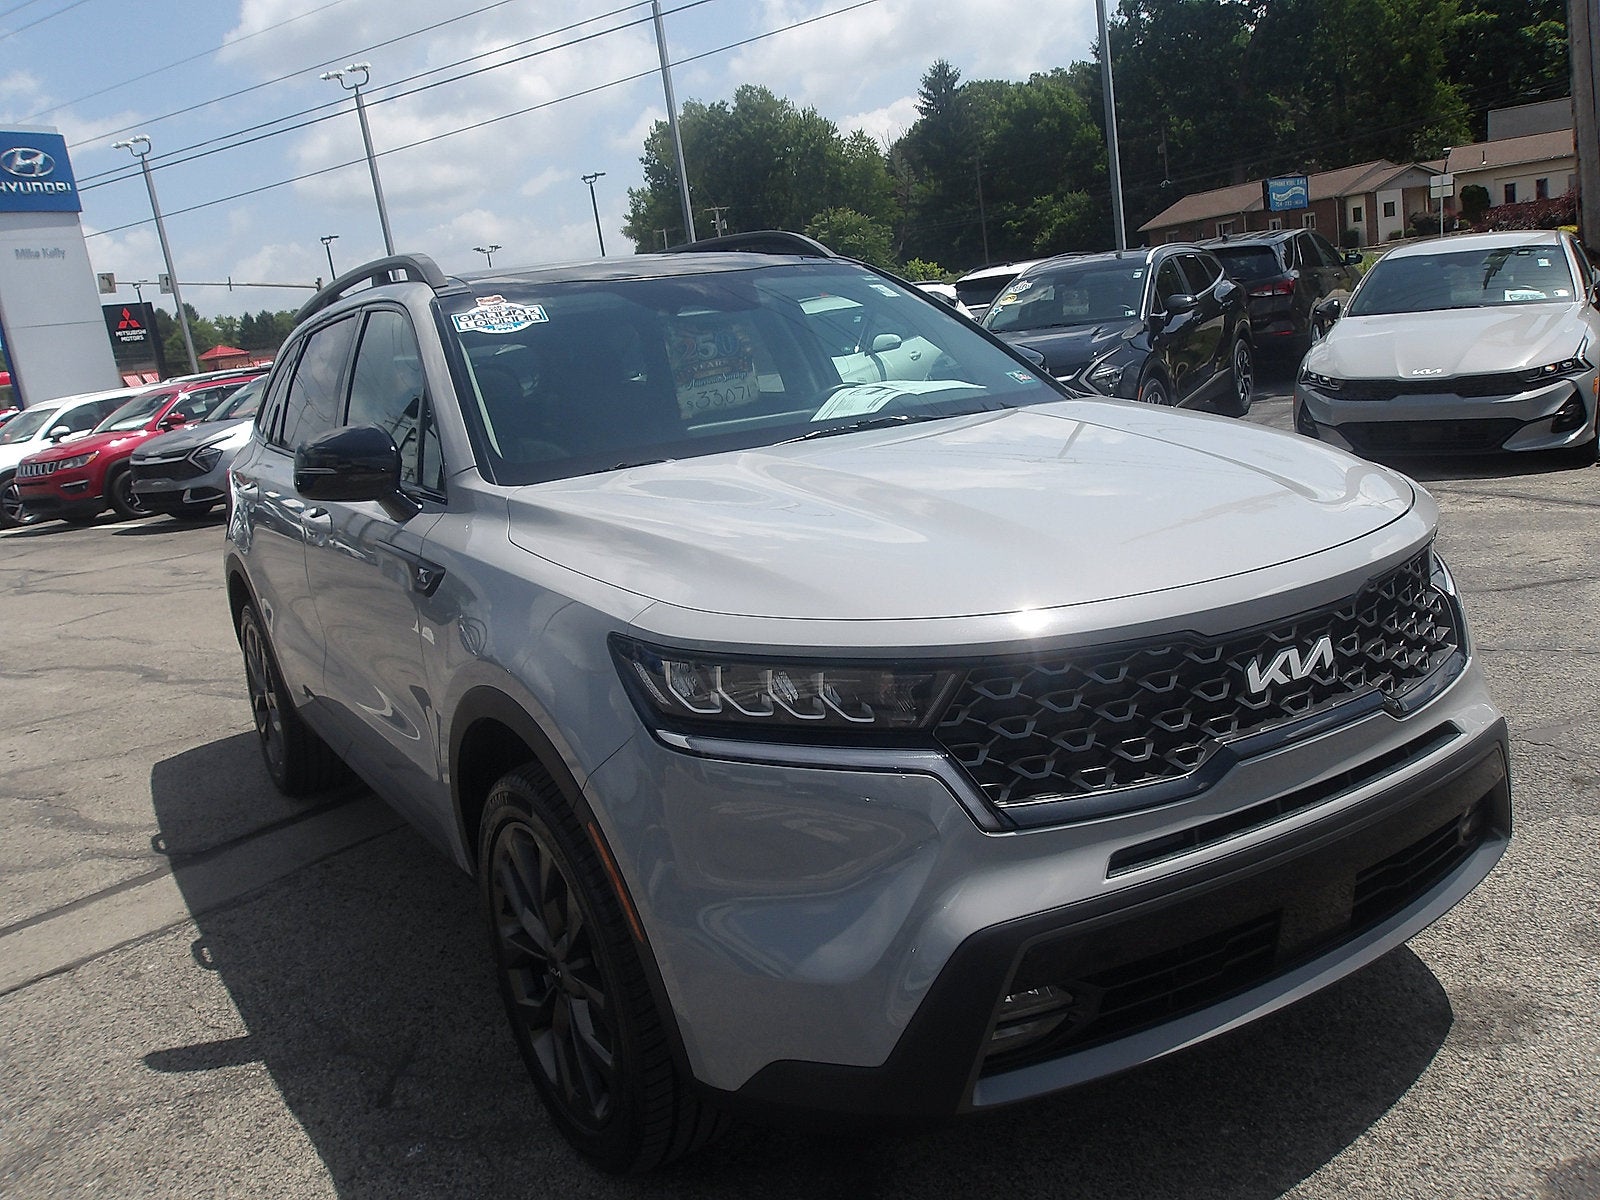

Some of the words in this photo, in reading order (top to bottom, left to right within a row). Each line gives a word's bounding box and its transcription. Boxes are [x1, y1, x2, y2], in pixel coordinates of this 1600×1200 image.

[15, 248, 40, 260] Mike
[42, 247, 66, 260] Kelly
[115, 329, 147, 338] MITSUBISHI
[120, 335, 145, 343] MOTORS
[1247, 636, 1334, 694] KIA
